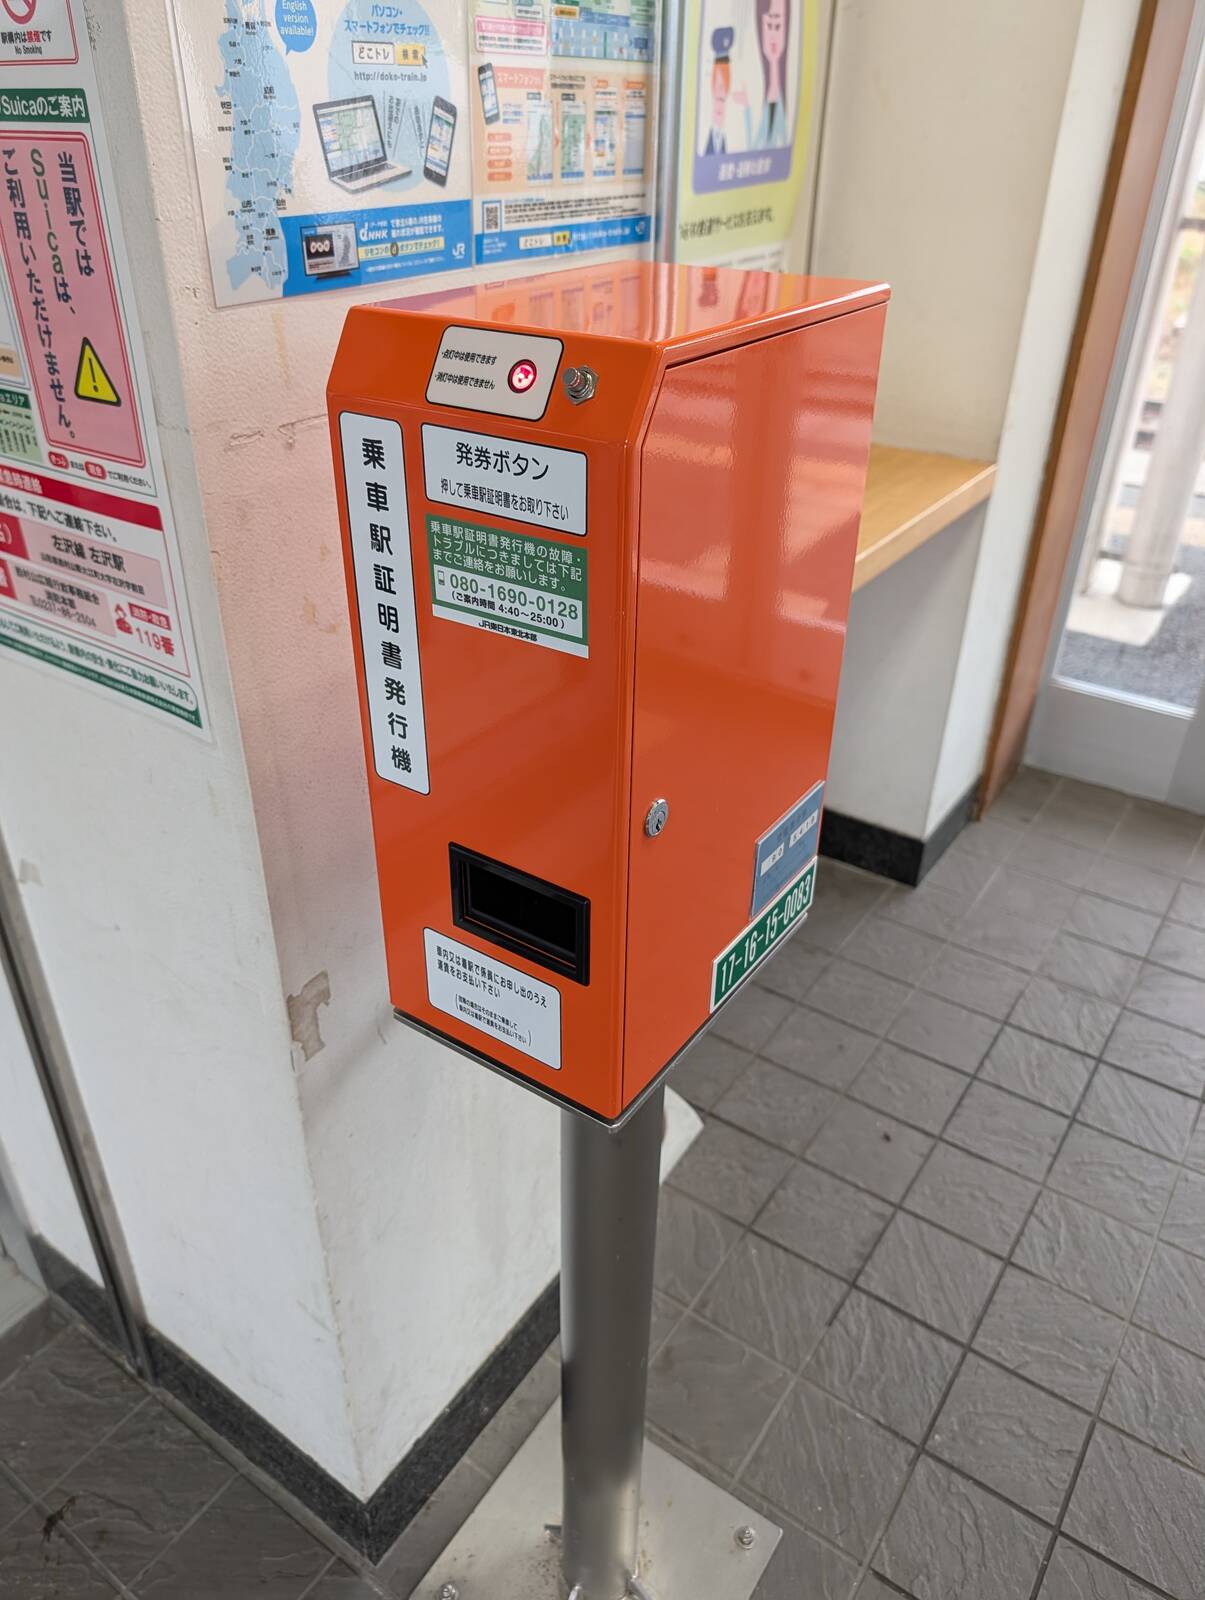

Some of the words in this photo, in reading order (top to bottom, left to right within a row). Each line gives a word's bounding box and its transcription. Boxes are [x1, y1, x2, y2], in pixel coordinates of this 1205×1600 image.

[282, 13, 309, 24] version
[15, 45, 23, 54] No
[23, 45, 43, 56] Smoking
[1, 95, 86, 118] Suicaのご案内
[58, 151, 95, 277] 当駅では
[452, 243, 466, 256] JR
[2, 147, 76, 439] ご利用いただけません。
[456, 441, 549, 481] 発券ボタン
[440, 477, 569, 521] 押して乗車駅証明書をお取り下さい
[90, 546, 126, 574] 左沢駅
[430, 520, 581, 564] 乗車駅証明書発行機の故障・
[433, 535, 582, 582] トラブルにつきましては下記
[433, 549, 566, 592] までご連絡をお願いします。
[362, 437, 412, 774] 乗車駅証明書発行機
[450, 573, 578, 620] 080-1690-0128
[136, 627, 175, 656] 119番
[720, 874, 812, 993] 17-16-15-0083
